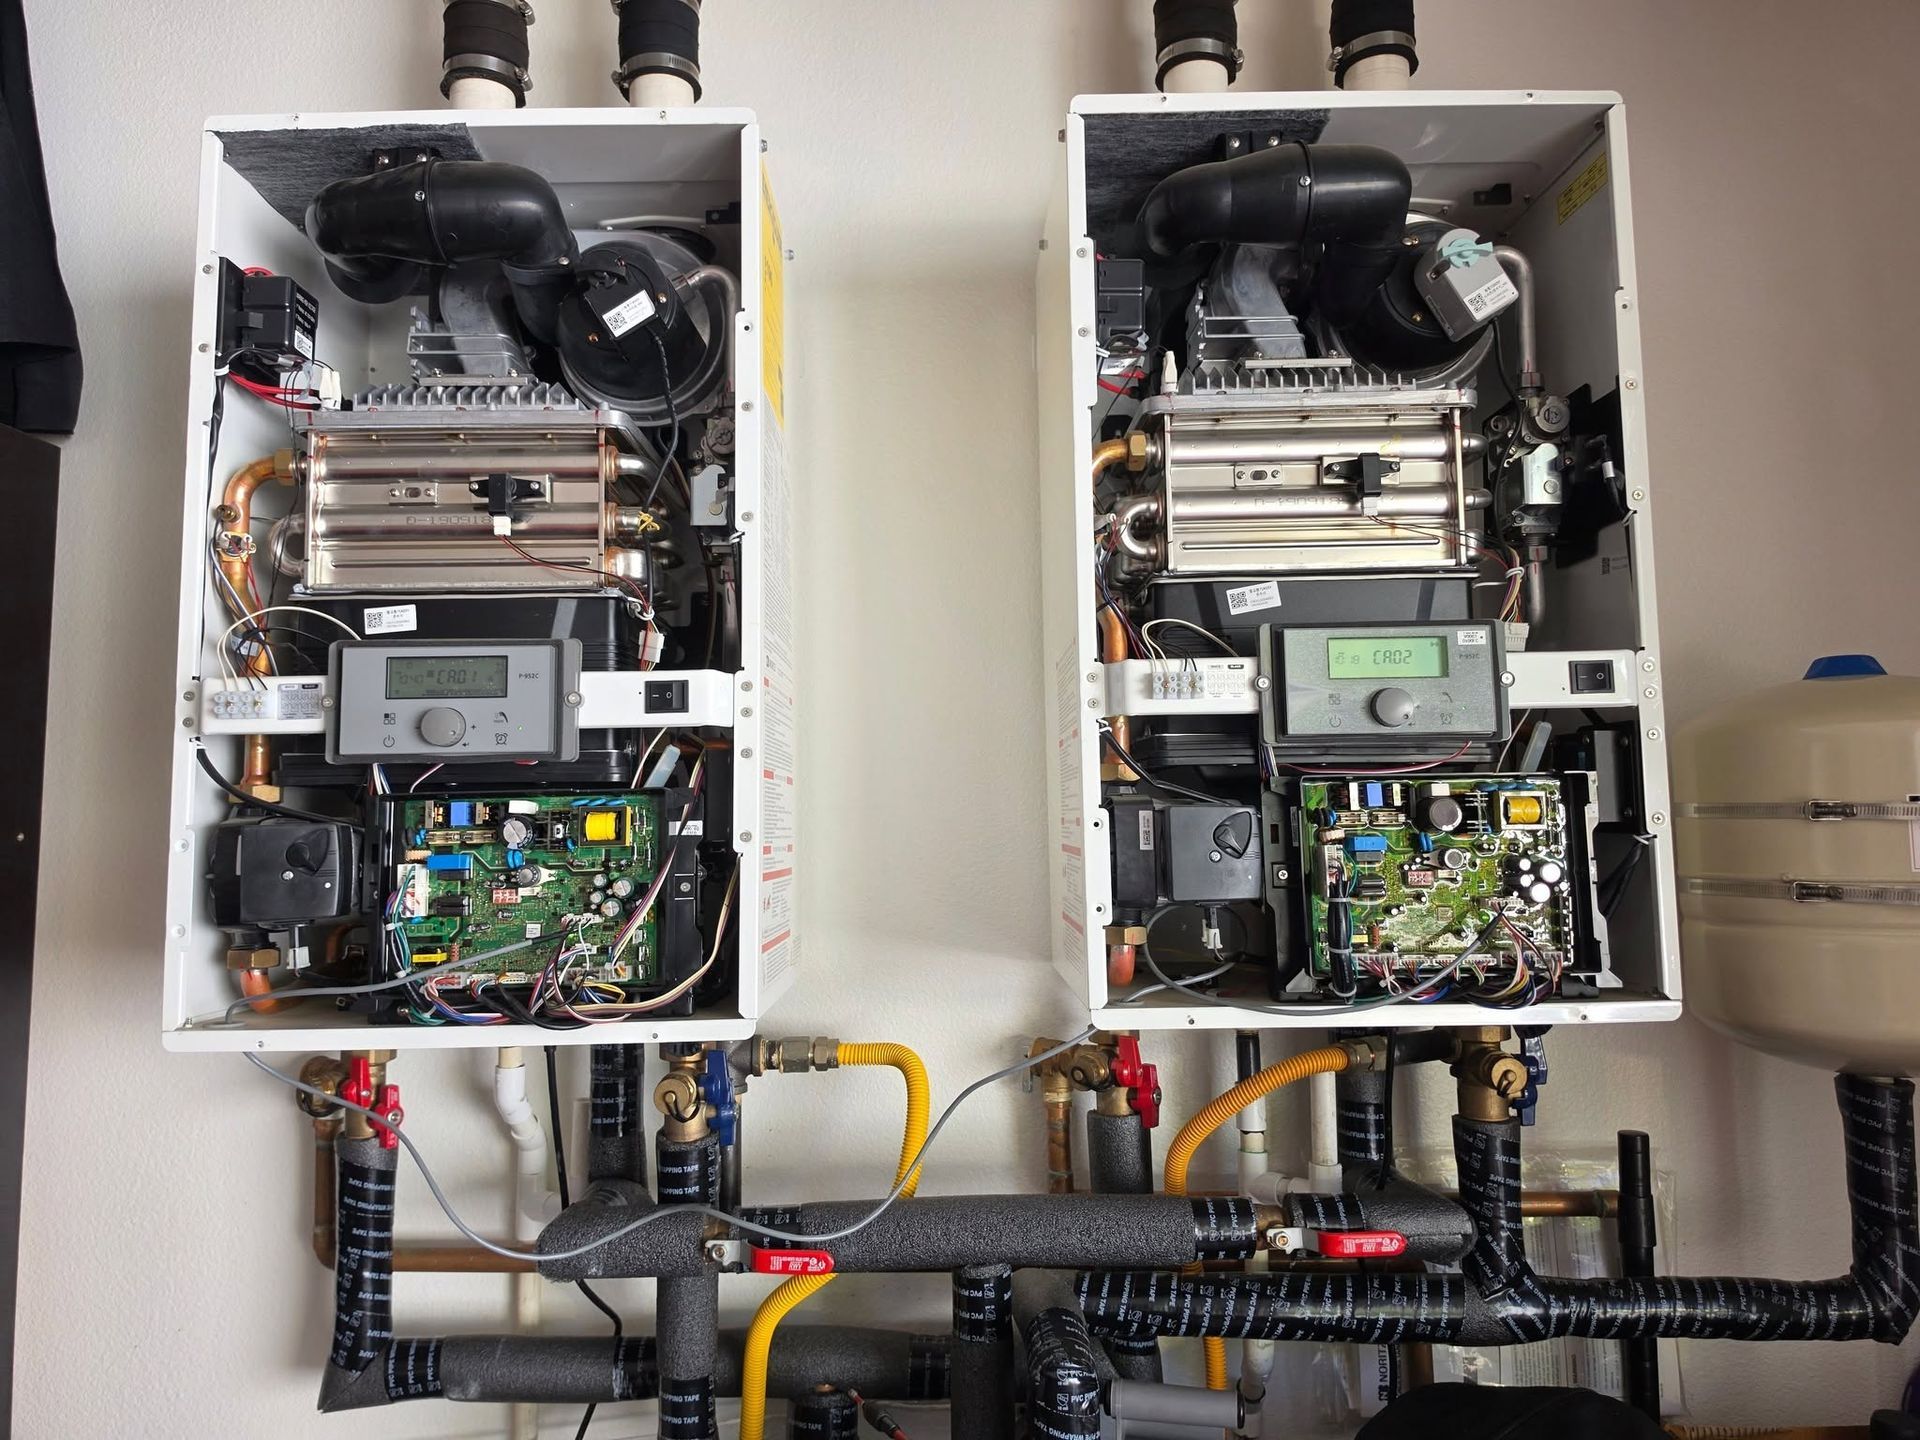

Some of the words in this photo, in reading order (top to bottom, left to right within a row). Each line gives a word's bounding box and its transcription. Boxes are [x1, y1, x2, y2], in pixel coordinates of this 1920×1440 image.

[1373, 650, 1412, 665] CA02
[683, 1164, 699, 1173] TAPE
[684, 1185, 700, 1194] TAPE
[1097, 1299, 1107, 1316] TAPE
[971, 1312, 984, 1320] PVC
[1117, 1304, 1127, 1321] TAPE
[684, 1394, 700, 1402] TAPE
[1071, 1395, 1084, 1403] PVC
[683, 1416, 699, 1424] TAPE
